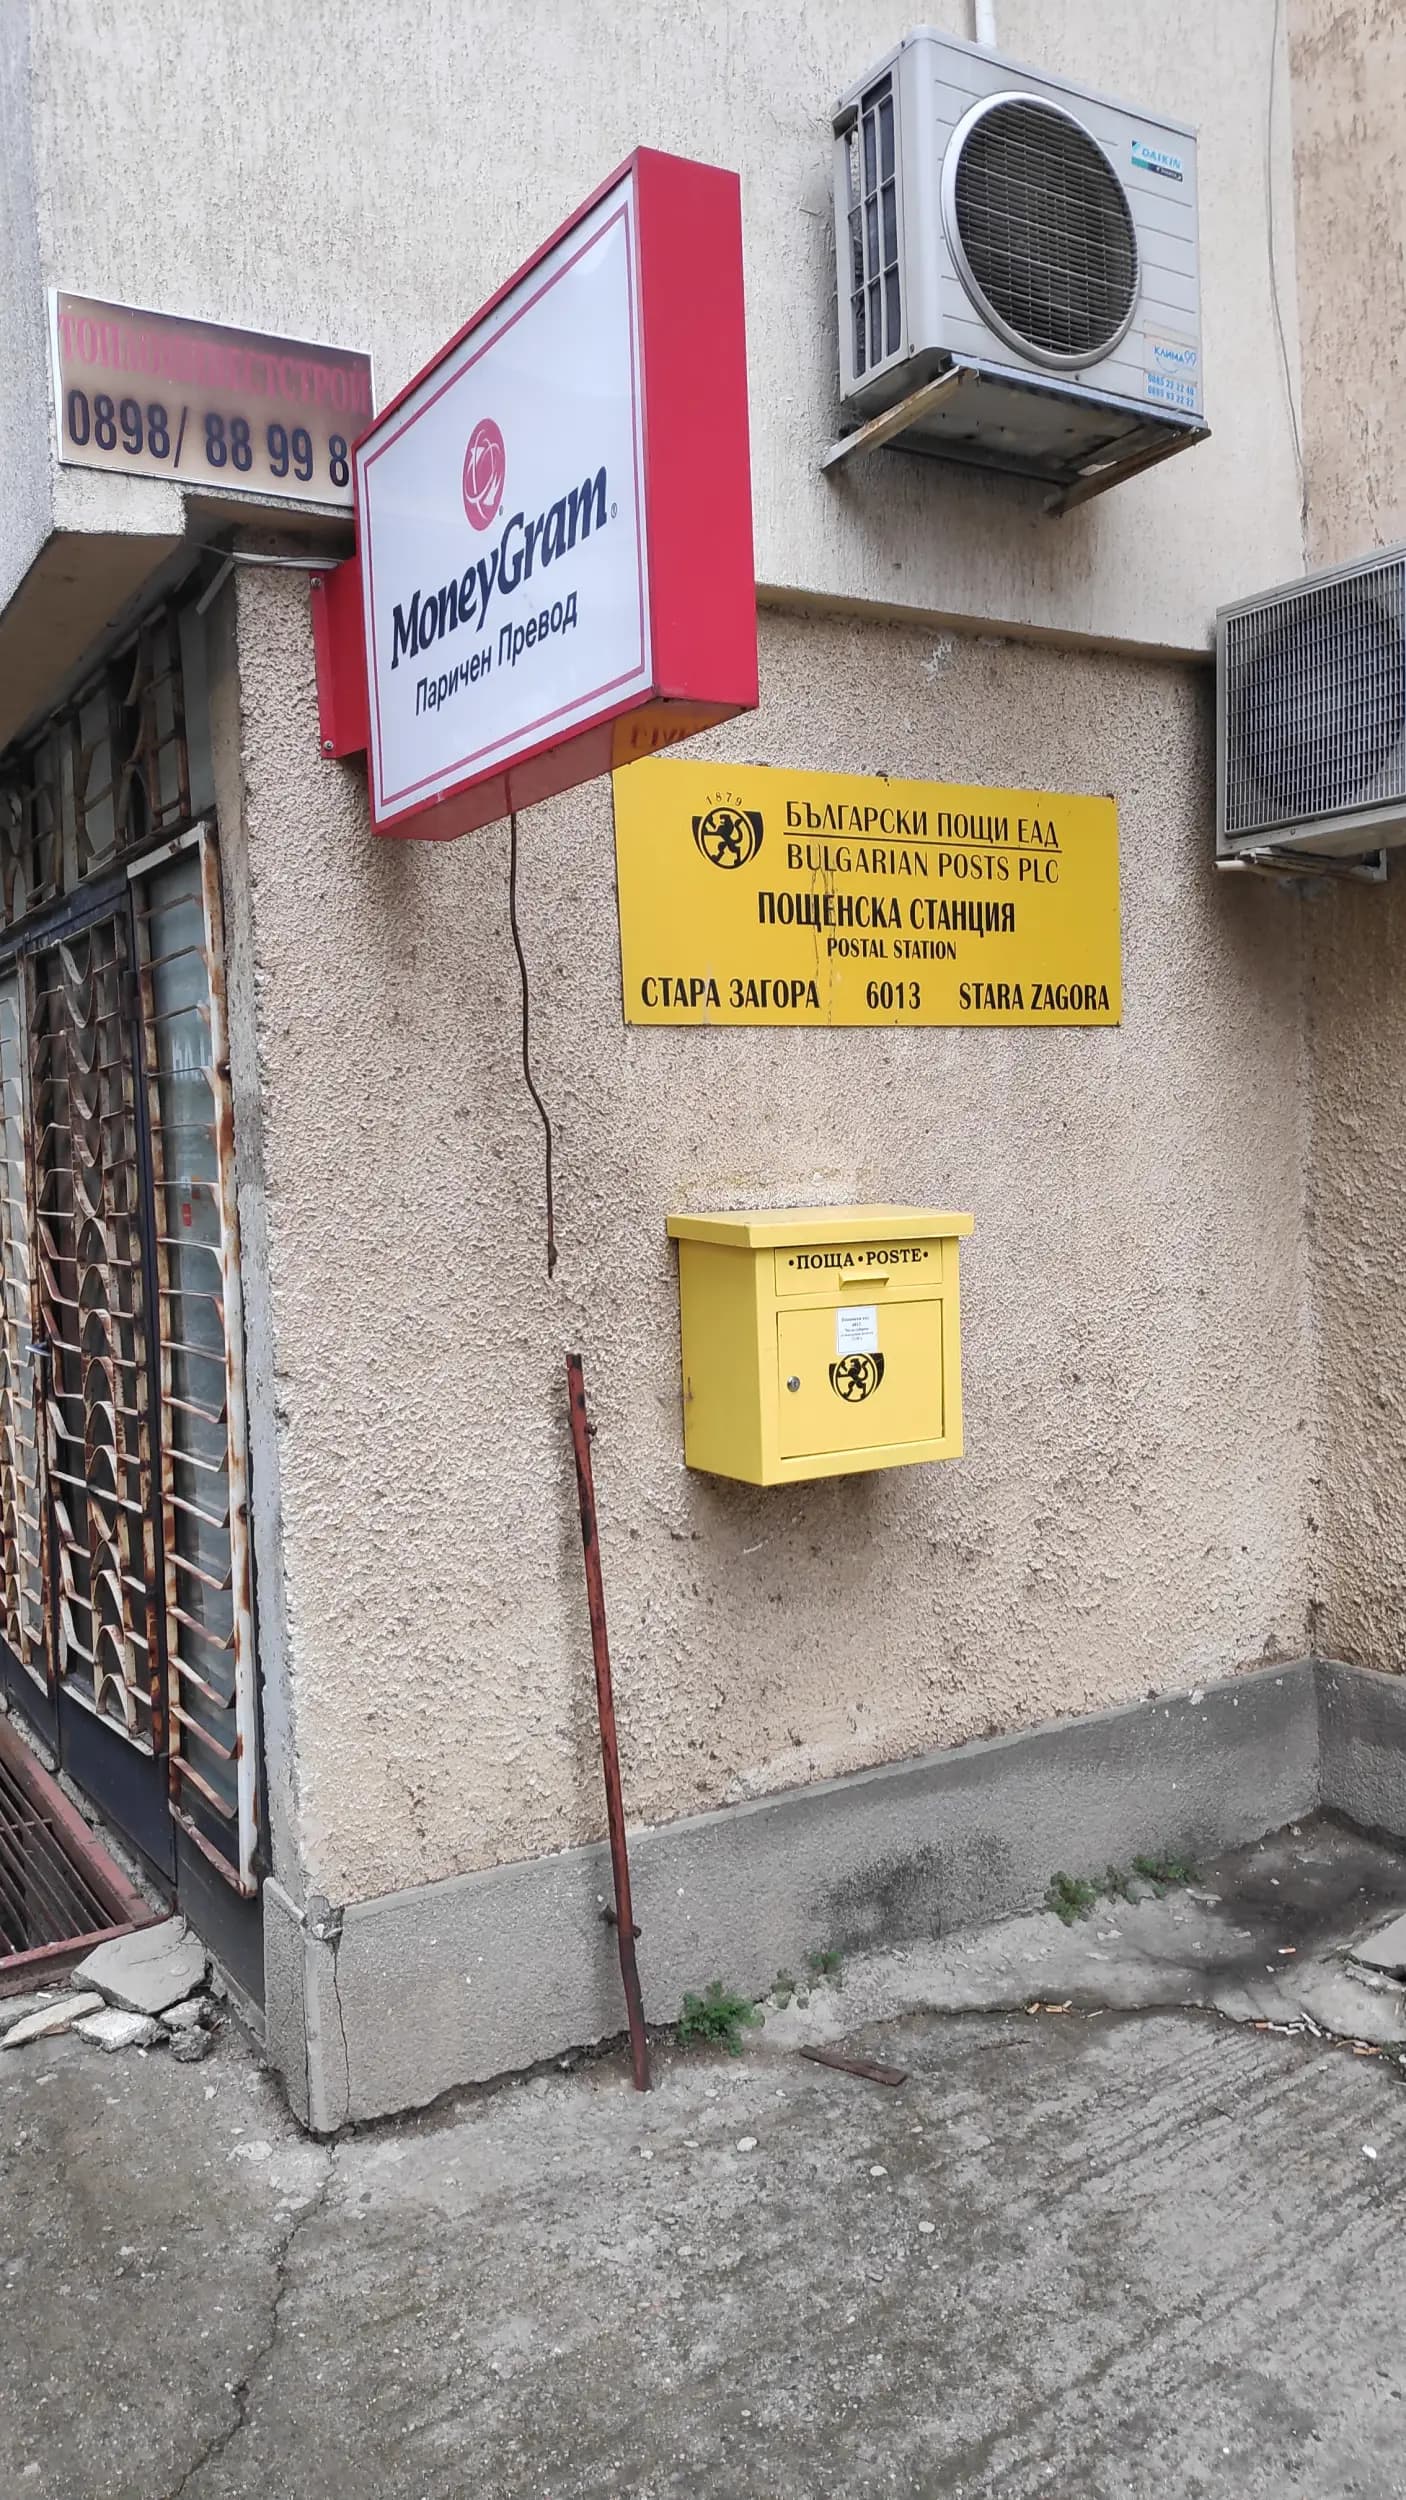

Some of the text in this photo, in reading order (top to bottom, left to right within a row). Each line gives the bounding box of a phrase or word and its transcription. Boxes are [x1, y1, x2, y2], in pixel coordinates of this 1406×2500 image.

[1142, 148, 1181, 169] DAIKIN
[68, 389, 187, 468] 0898/
[205, 412, 252, 472] 88
[267, 424, 314, 482] 99
[391, 466, 608, 670] MoneyGram
[415, 590, 578, 716] Паричен Превод
[705, 791, 743, 808] 1879
[786, 801, 1059, 848] БЪЛГАРСКИ ПОЩИ ЕАД
[787, 843, 1059, 883] BULGARIAN POSTS PLC
[758, 891, 1016, 938] ПОЩЕНСКА СТАНЦИЯ
[827, 937, 957, 960] POSTAL STATION
[641, 976, 1110, 1011] СТАРА ЗАГОРА 6013 STARA ZAGORA
